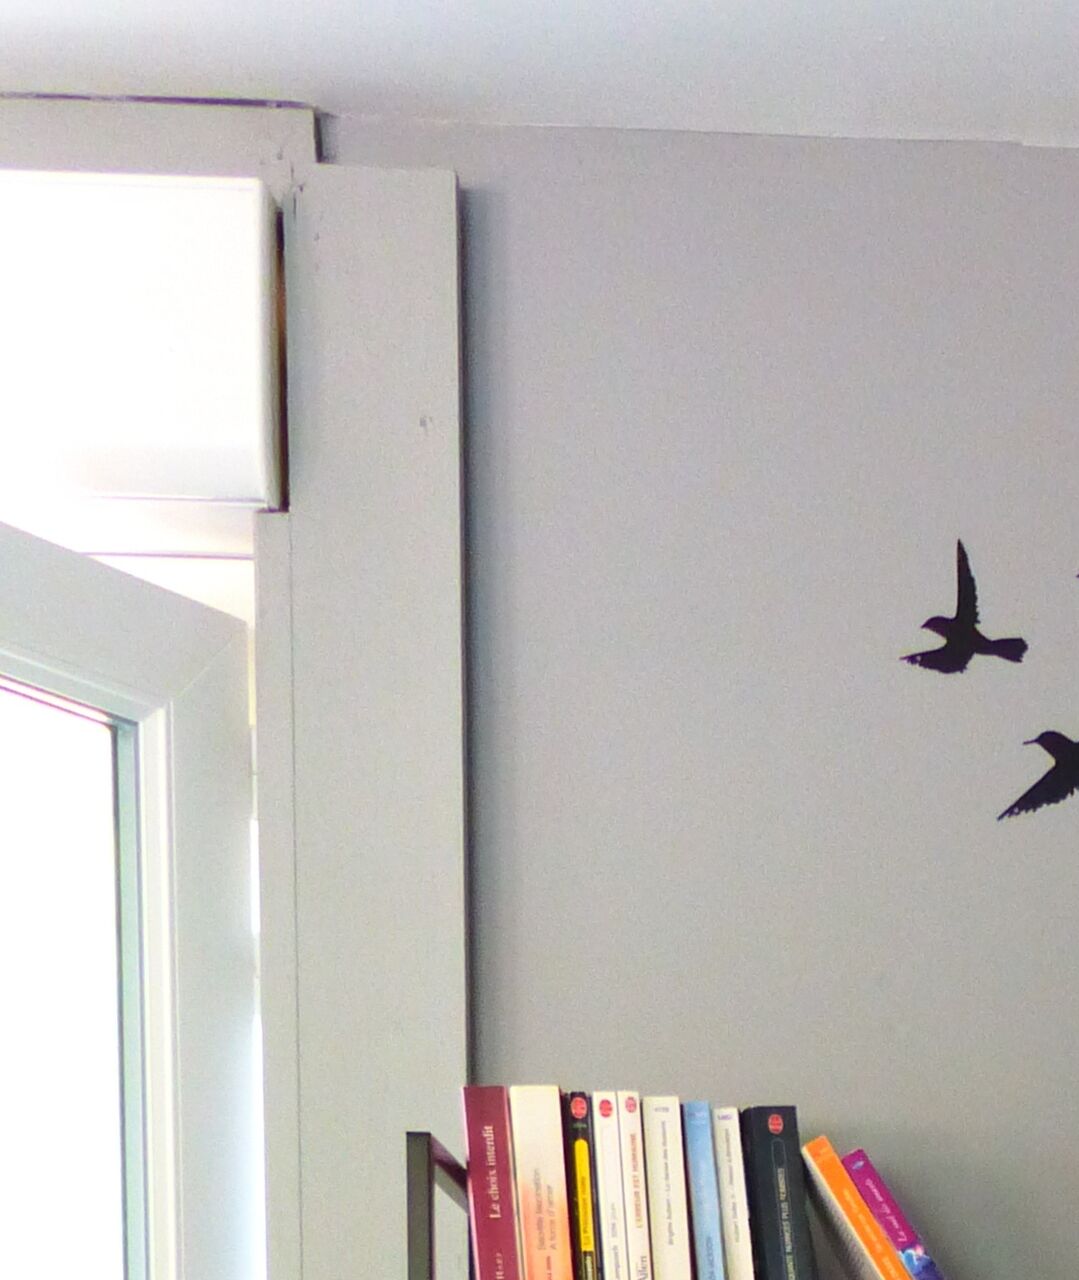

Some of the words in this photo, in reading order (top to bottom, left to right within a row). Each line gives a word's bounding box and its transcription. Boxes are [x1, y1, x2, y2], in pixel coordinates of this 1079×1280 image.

[484, 1125, 497, 1166] interdit
[487, 1169, 500, 1201] choix
[489, 1203, 501, 1218] Le
